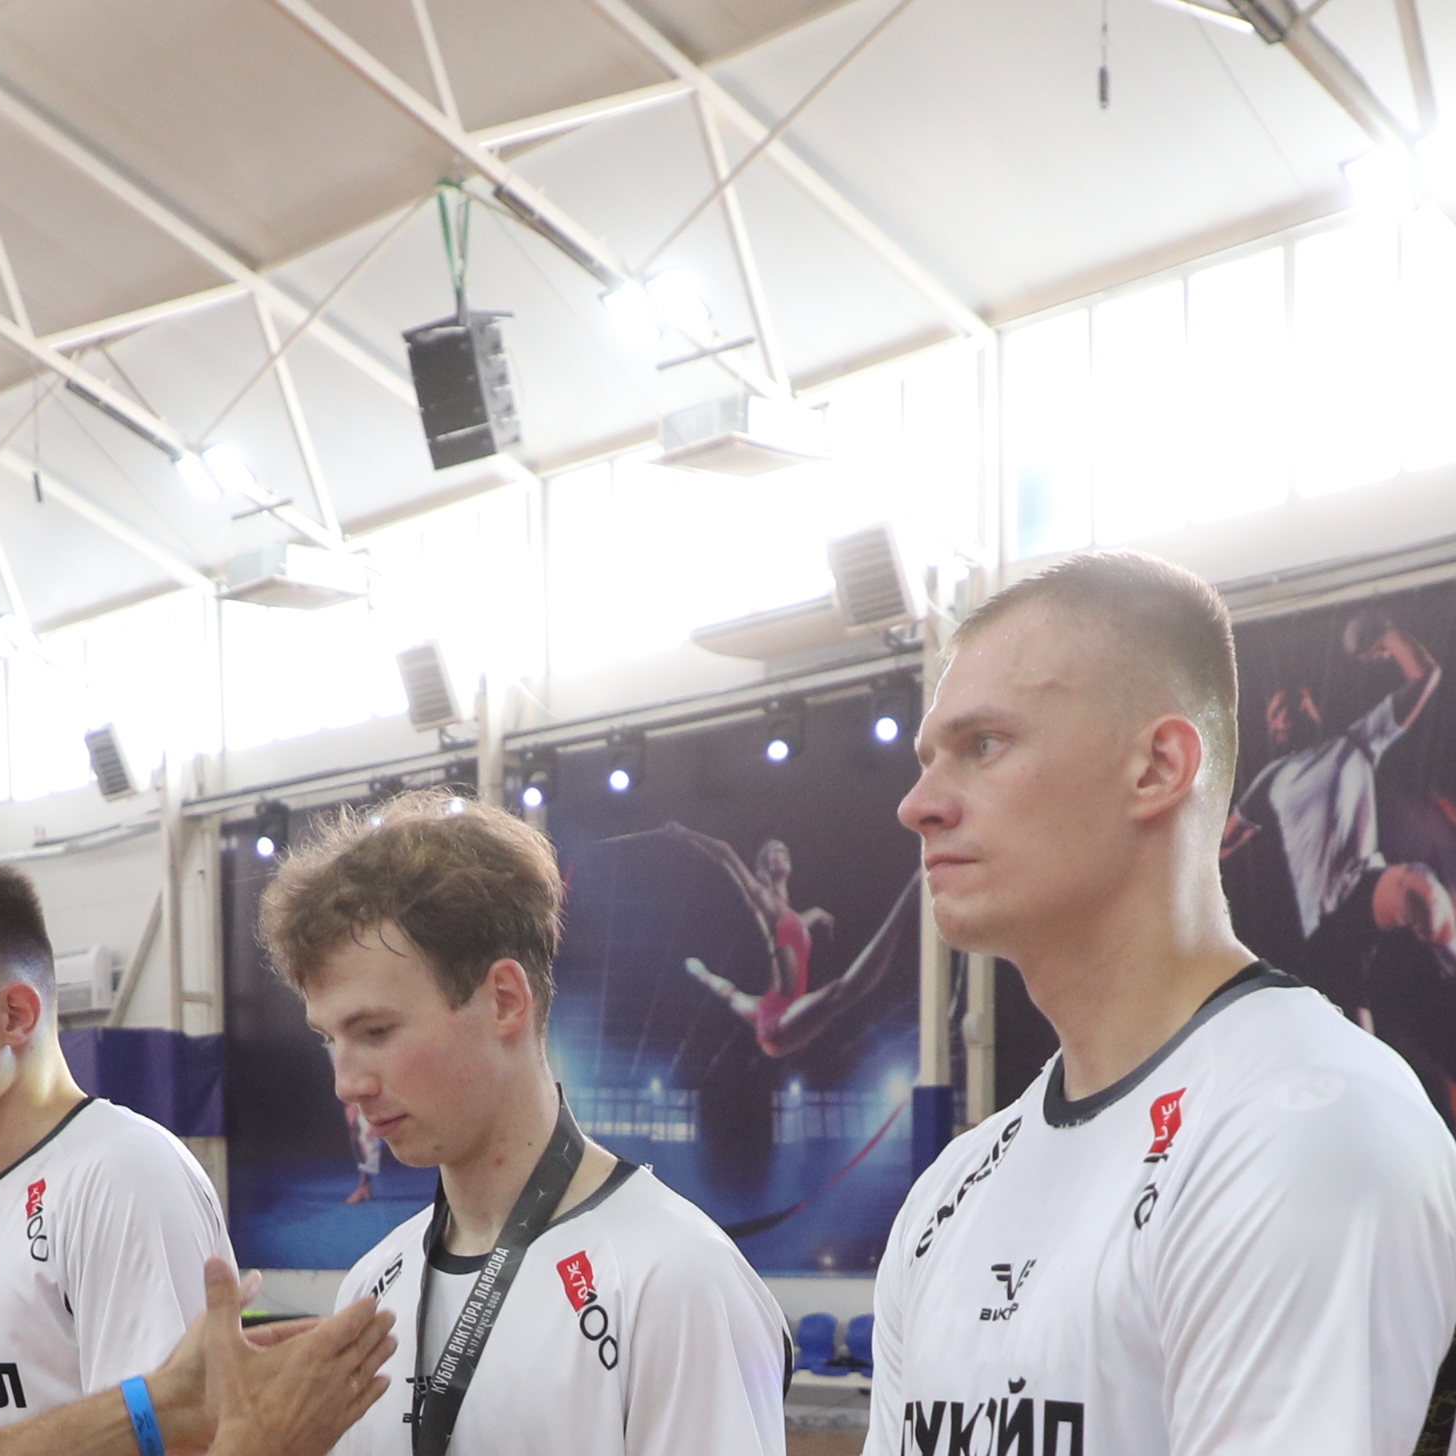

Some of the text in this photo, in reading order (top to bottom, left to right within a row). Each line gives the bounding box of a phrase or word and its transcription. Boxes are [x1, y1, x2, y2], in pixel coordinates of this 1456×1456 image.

[431, 1246, 510, 1395] КУБОК ВИКТОРА ЛАВРОВА
